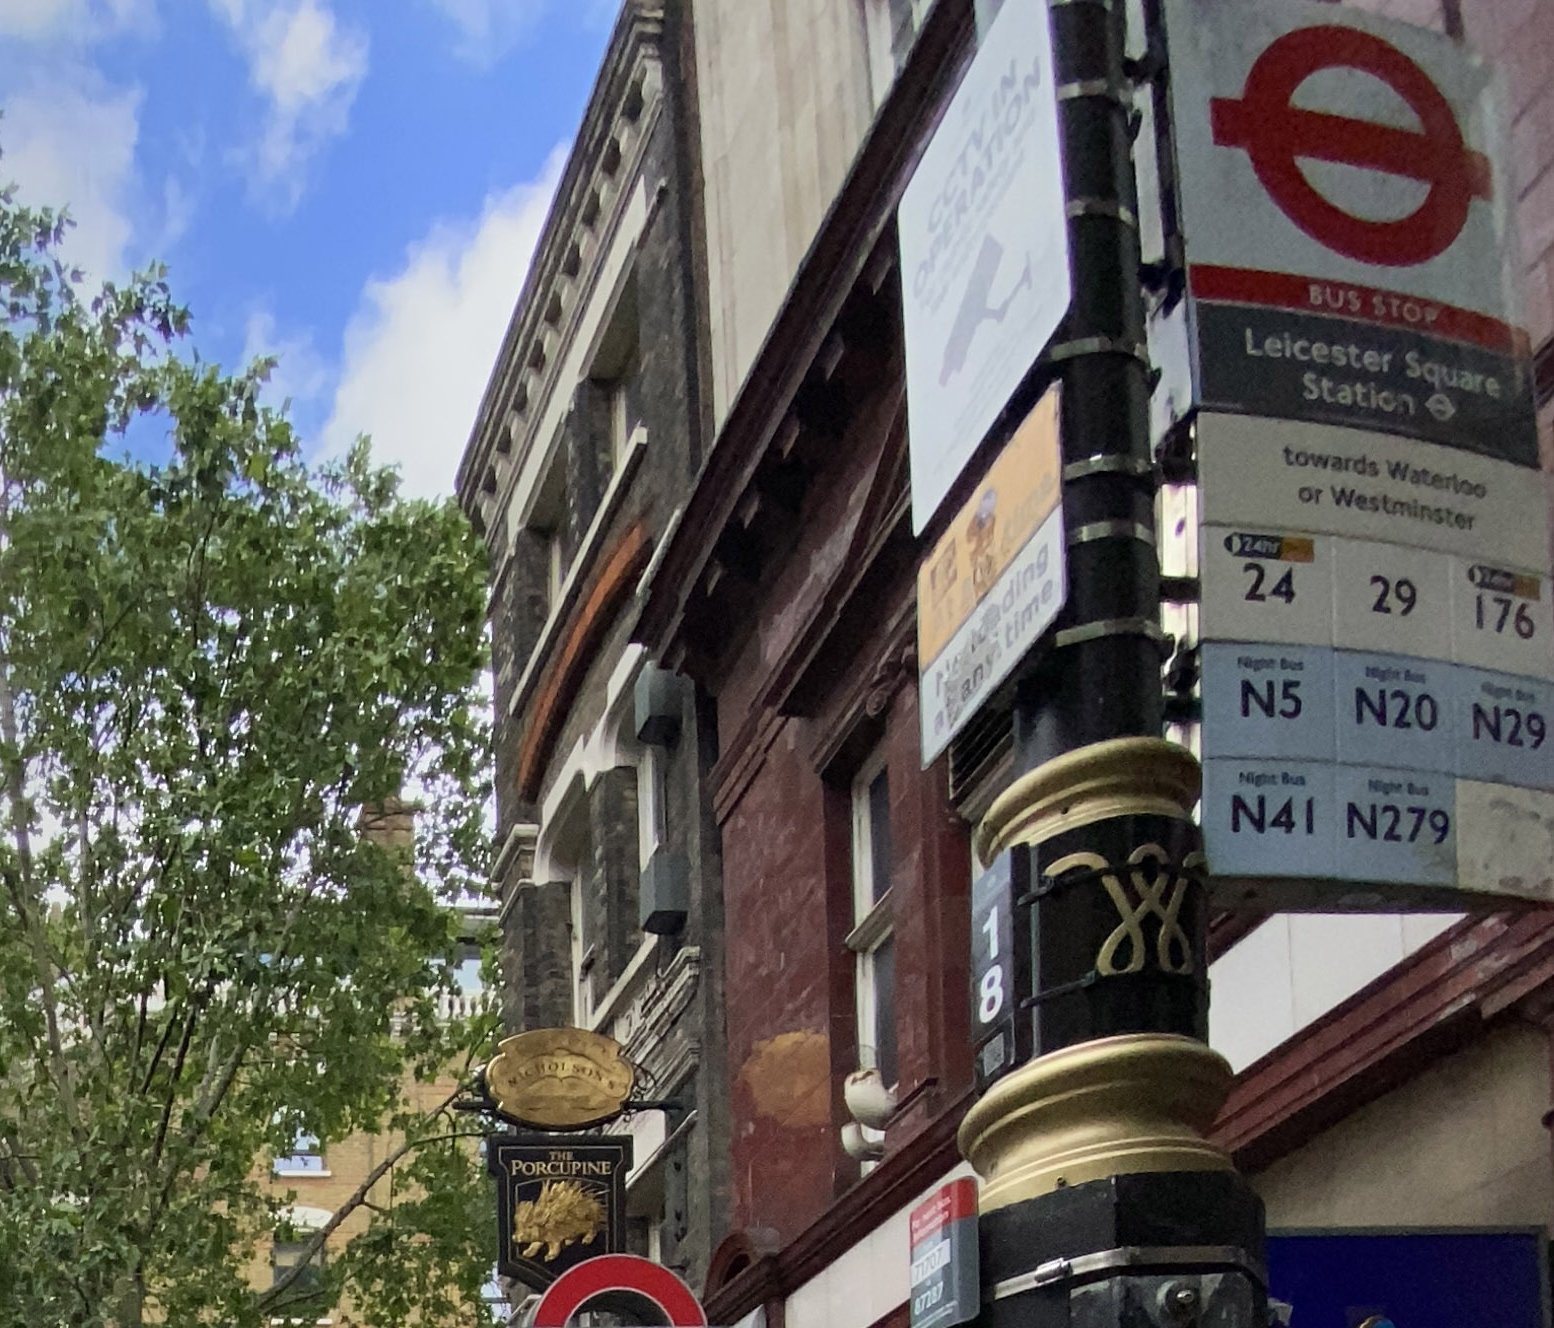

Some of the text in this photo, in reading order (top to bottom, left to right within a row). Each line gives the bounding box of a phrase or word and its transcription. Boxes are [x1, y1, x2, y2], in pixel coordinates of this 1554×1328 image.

[1308, 284, 1441, 324] BUS STOP
[1244, 327, 1501, 399] Leicester Square
[1302, 371, 1416, 416] Station
[1282, 445, 1488, 500] towards Waterloo
[1298, 484, 1476, 531] or Westminster
[1004, 577, 1054, 650] time
[1242, 561, 1536, 640] 24 29 176
[1239, 678, 1548, 750] N5 N20 N29
[1230, 793, 1451, 845] N41 N279
[510, 1159, 613, 1176] PORCUPINE
[549, 1151, 574, 1161] THE
